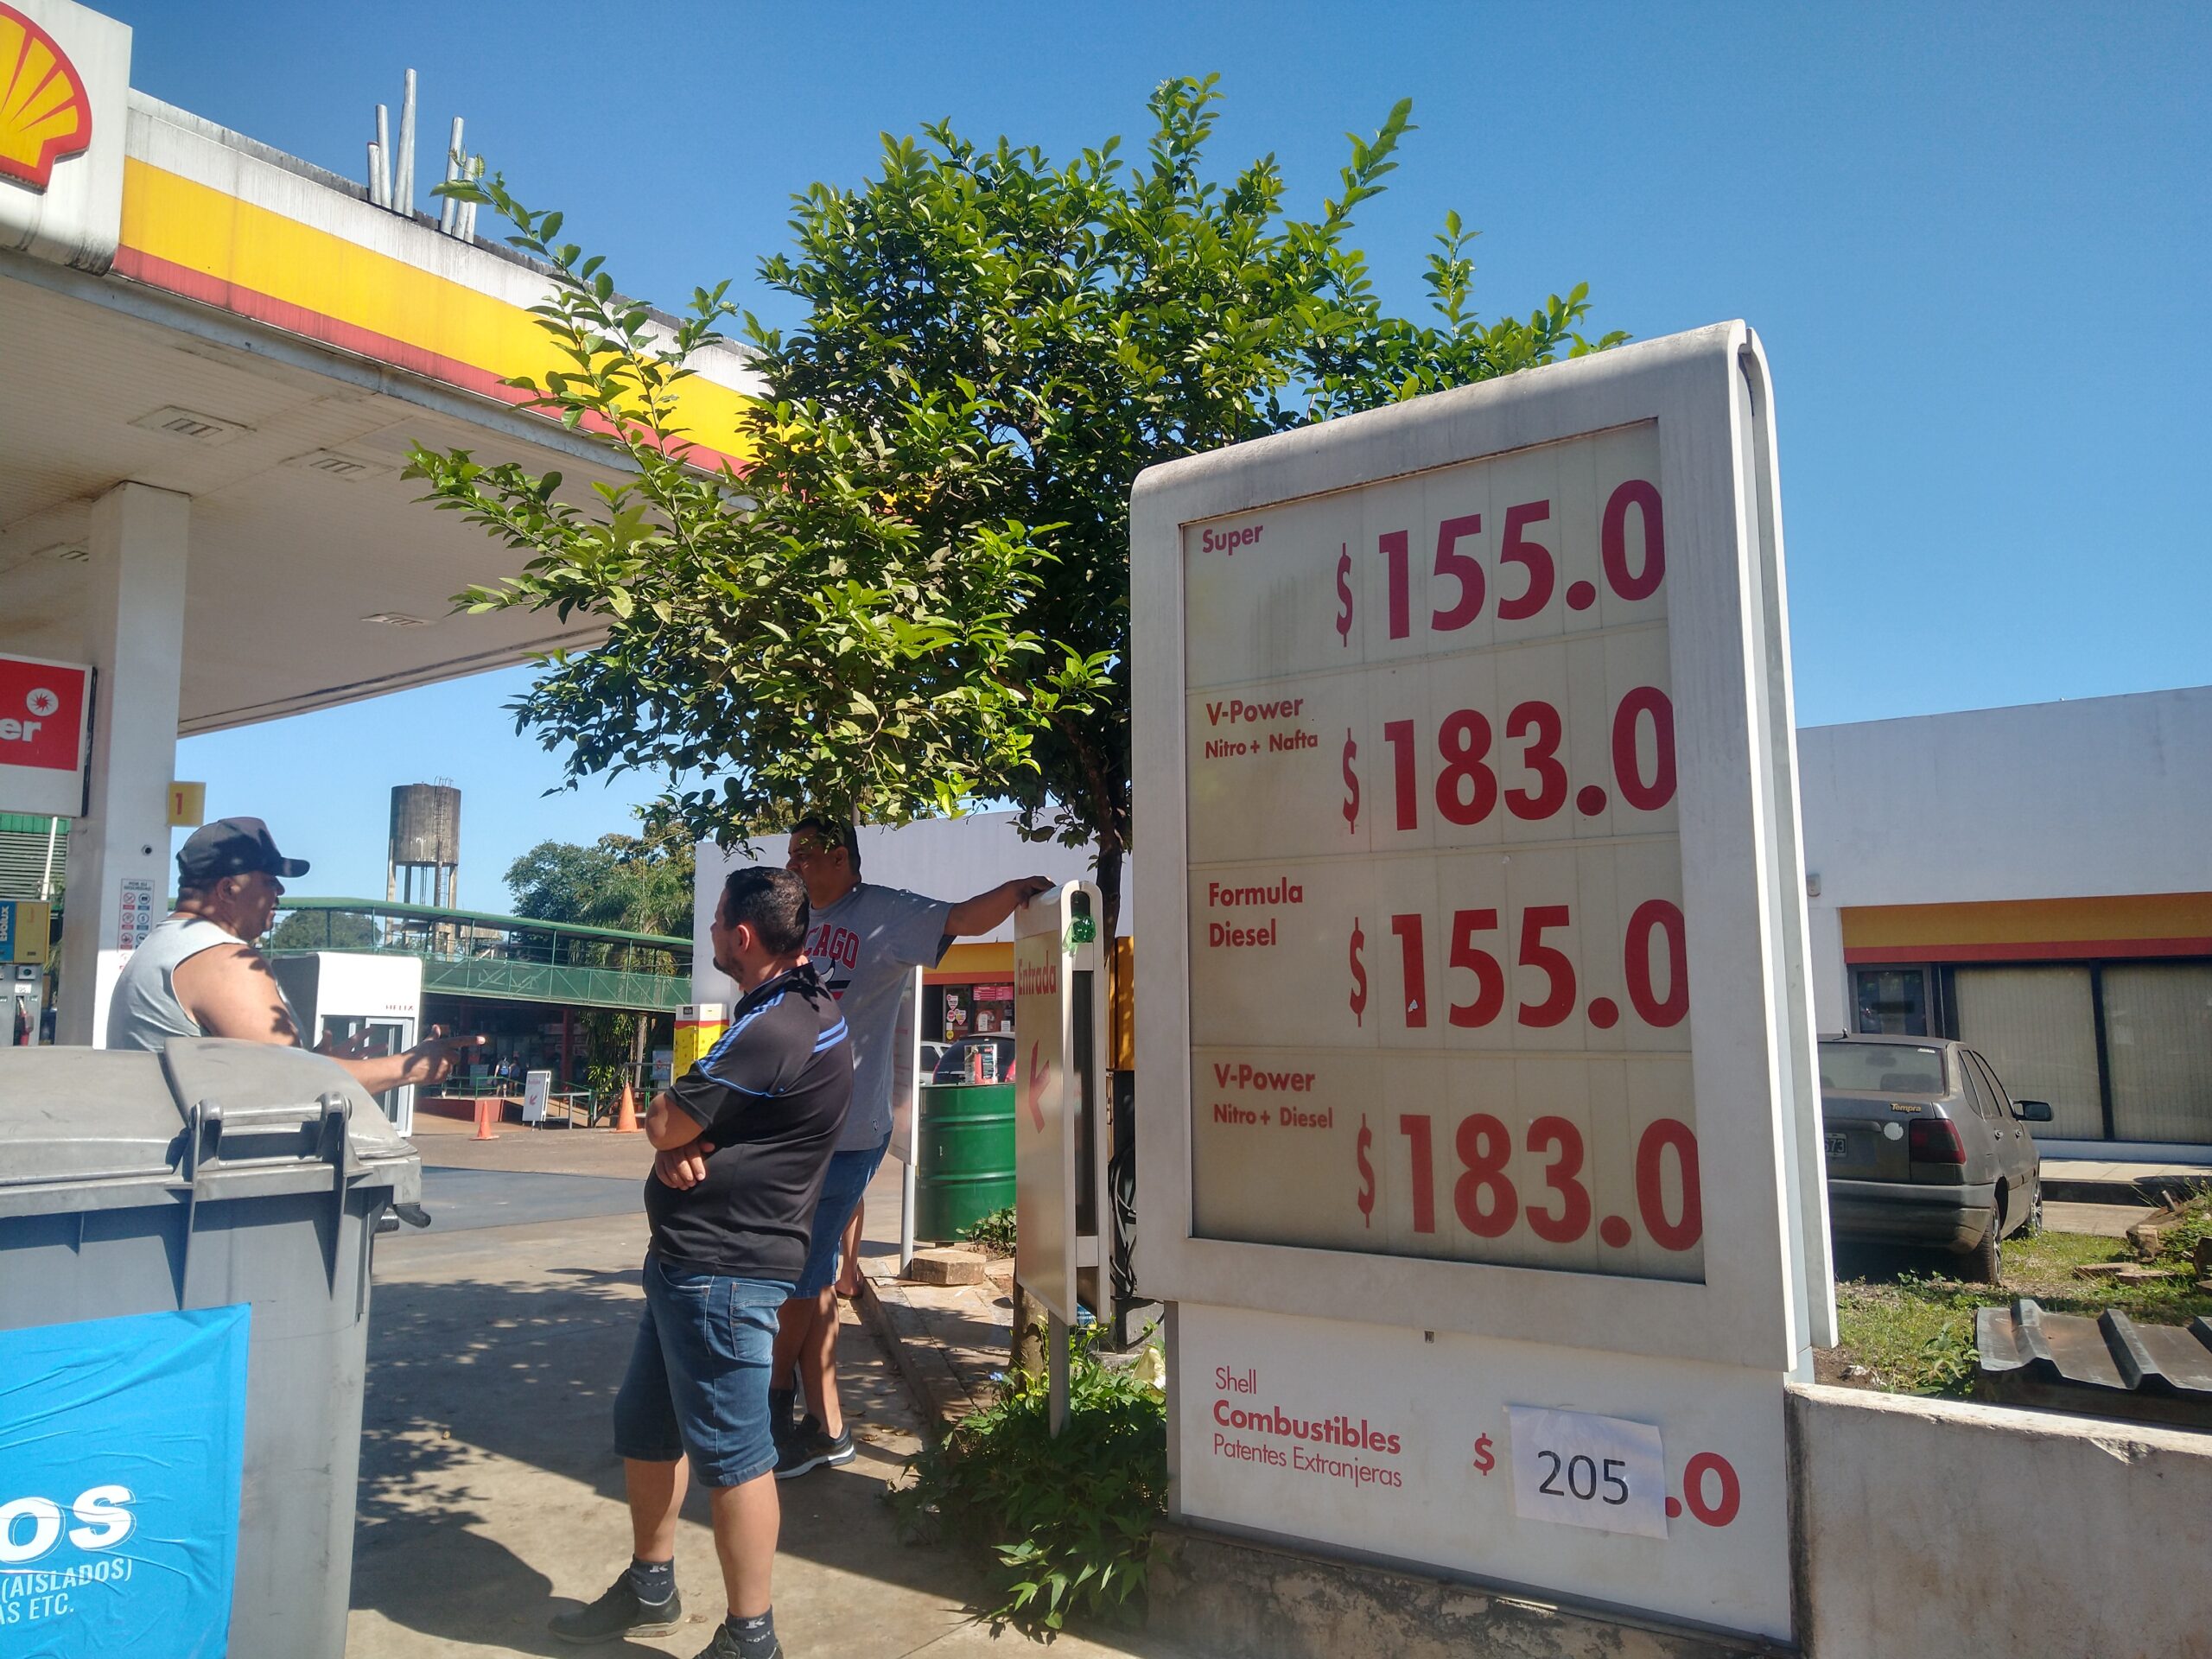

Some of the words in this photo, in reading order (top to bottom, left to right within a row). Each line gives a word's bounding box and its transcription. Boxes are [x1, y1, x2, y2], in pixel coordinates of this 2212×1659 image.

[1203, 525, 1263, 556] Super
[1206, 699, 1303, 726] V-Power
[1269, 731, 1318, 752] Nafta
[175, 792, 183, 815] 1
[1209, 877, 1303, 906] Formula
[1209, 918, 1276, 948] Diesel
[1018, 950, 1057, 995] Entrada
[1213, 1064, 1315, 1092] V-Power
[1280, 1106, 1333, 1128] Diesel
[1890, 1103, 1922, 1113] Tempra
[1215, 1367, 1257, 1394] Shell
[1213, 1400, 1401, 1455] Combustibles
[1213, 1433, 1287, 1467] Patentes
[1294, 1446, 1402, 1488] Extranjeras
[1474, 1433, 1495, 1476] $
[1537, 1450, 1630, 1505] 205
[2, 1558, 132, 1604] (AISLADOS)
[29, 1592, 74, 1620] ETC.
